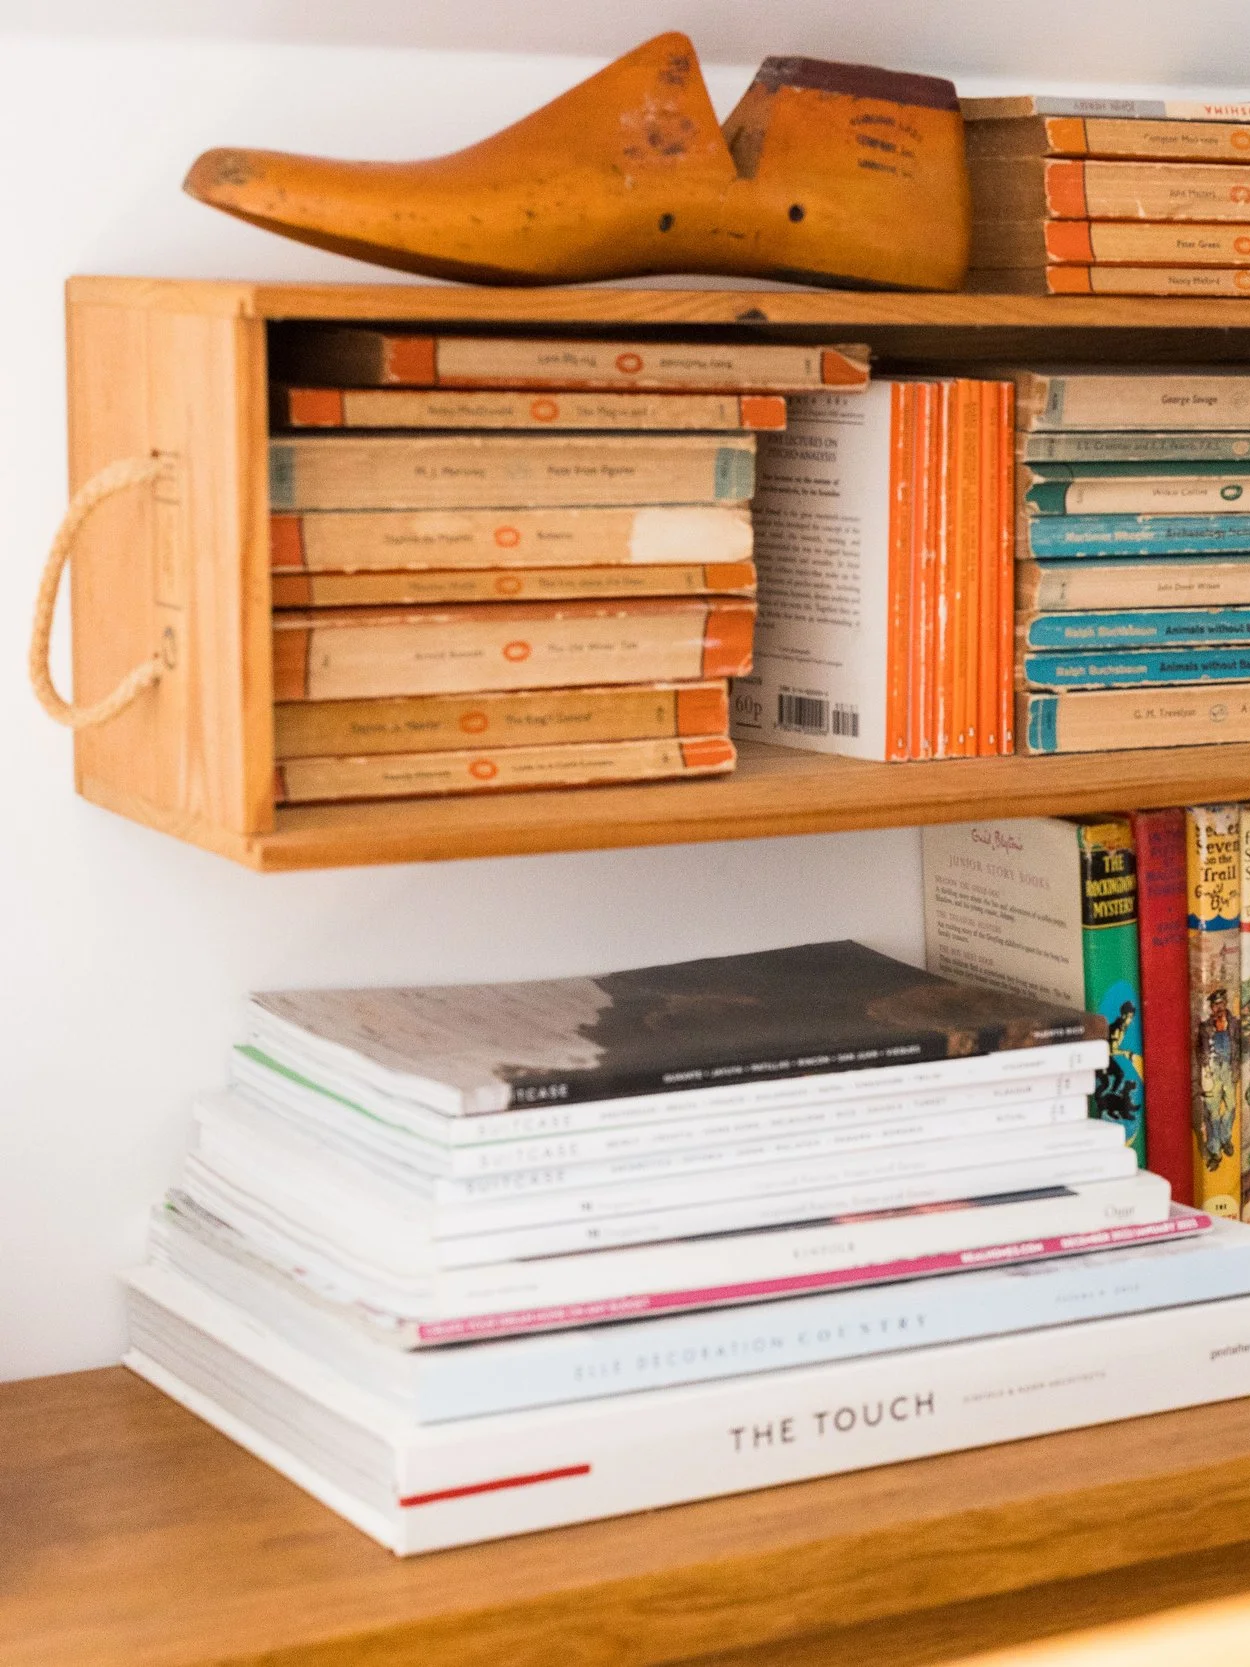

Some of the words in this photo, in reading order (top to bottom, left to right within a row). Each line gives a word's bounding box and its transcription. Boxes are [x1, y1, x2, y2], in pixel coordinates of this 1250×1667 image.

[1165, 624, 1205, 636] Animals
[1207, 622, 1245, 635] without
[1159, 660, 1199, 673] Animals
[1201, 658, 1238, 671] without
[735, 694, 763, 721] 60p
[1103, 854, 1125, 874] THE
[1092, 897, 1135, 919] MYSTERY
[636, 1335, 785, 1372] DECORATION
[797, 1311, 929, 1347] COUNTRY
[729, 1416, 797, 1453] THE
[812, 1390, 936, 1436] TOUCH
